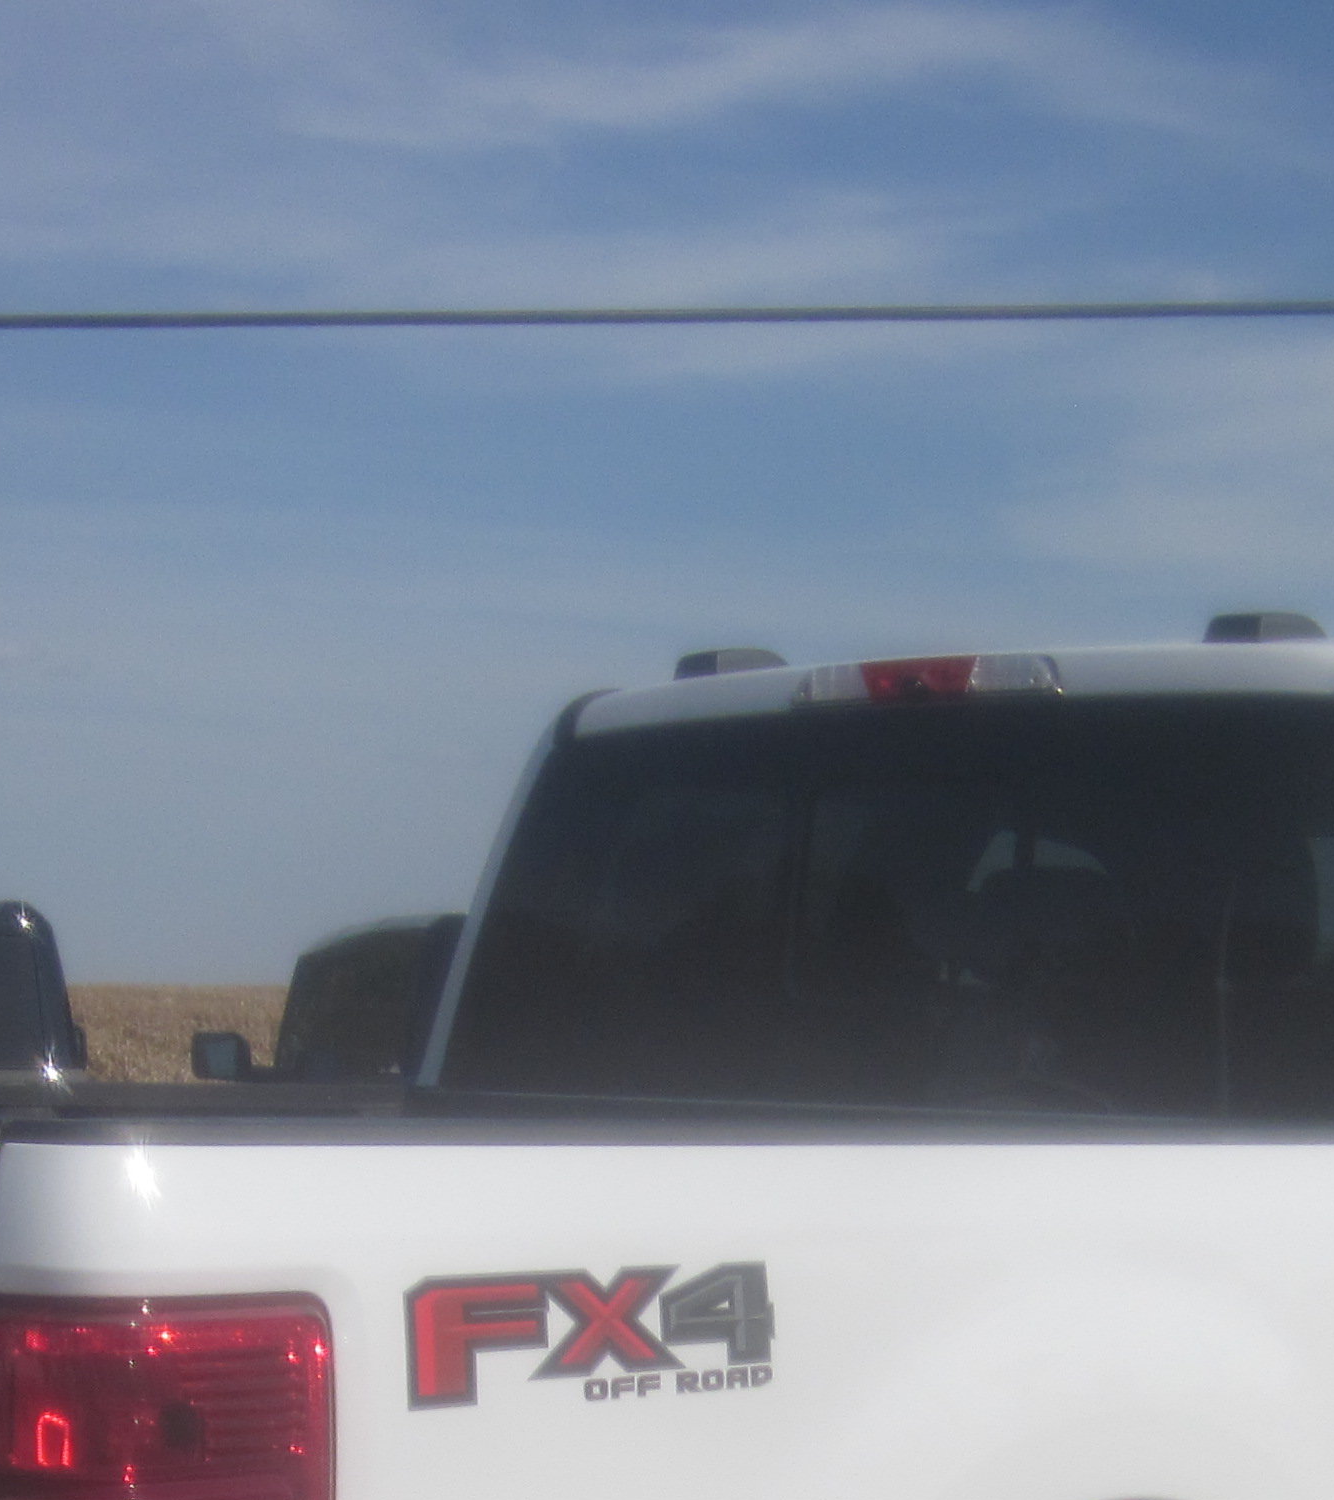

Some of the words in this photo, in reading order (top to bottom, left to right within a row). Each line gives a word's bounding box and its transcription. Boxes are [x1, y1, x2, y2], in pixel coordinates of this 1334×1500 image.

[403, 1261, 775, 1411] FX4
[583, 1373, 660, 1402] OFF
[675, 1364, 774, 1395] ROAD
